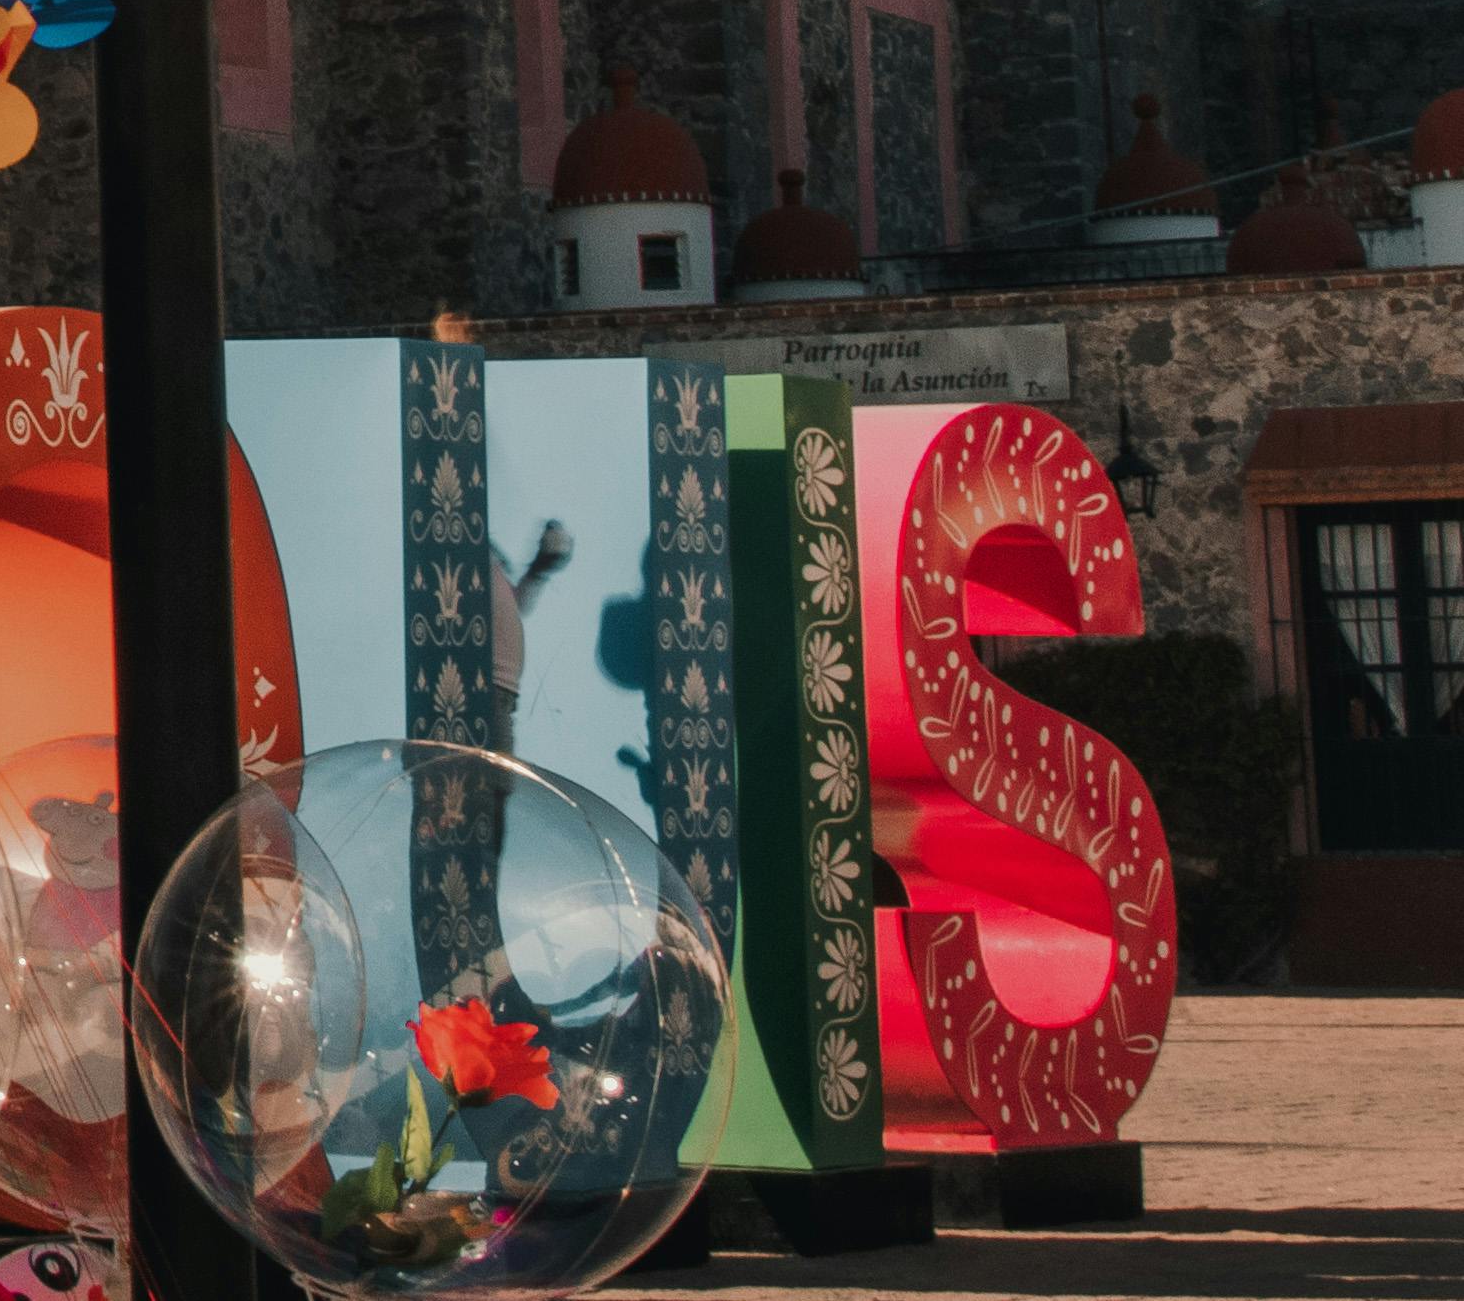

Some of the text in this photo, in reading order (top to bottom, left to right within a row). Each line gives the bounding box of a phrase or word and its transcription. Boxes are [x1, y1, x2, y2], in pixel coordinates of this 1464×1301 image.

[783, 335, 922, 368] Parroquia
[861, 370, 885, 394] la
[890, 366, 1009, 393] Asunción
